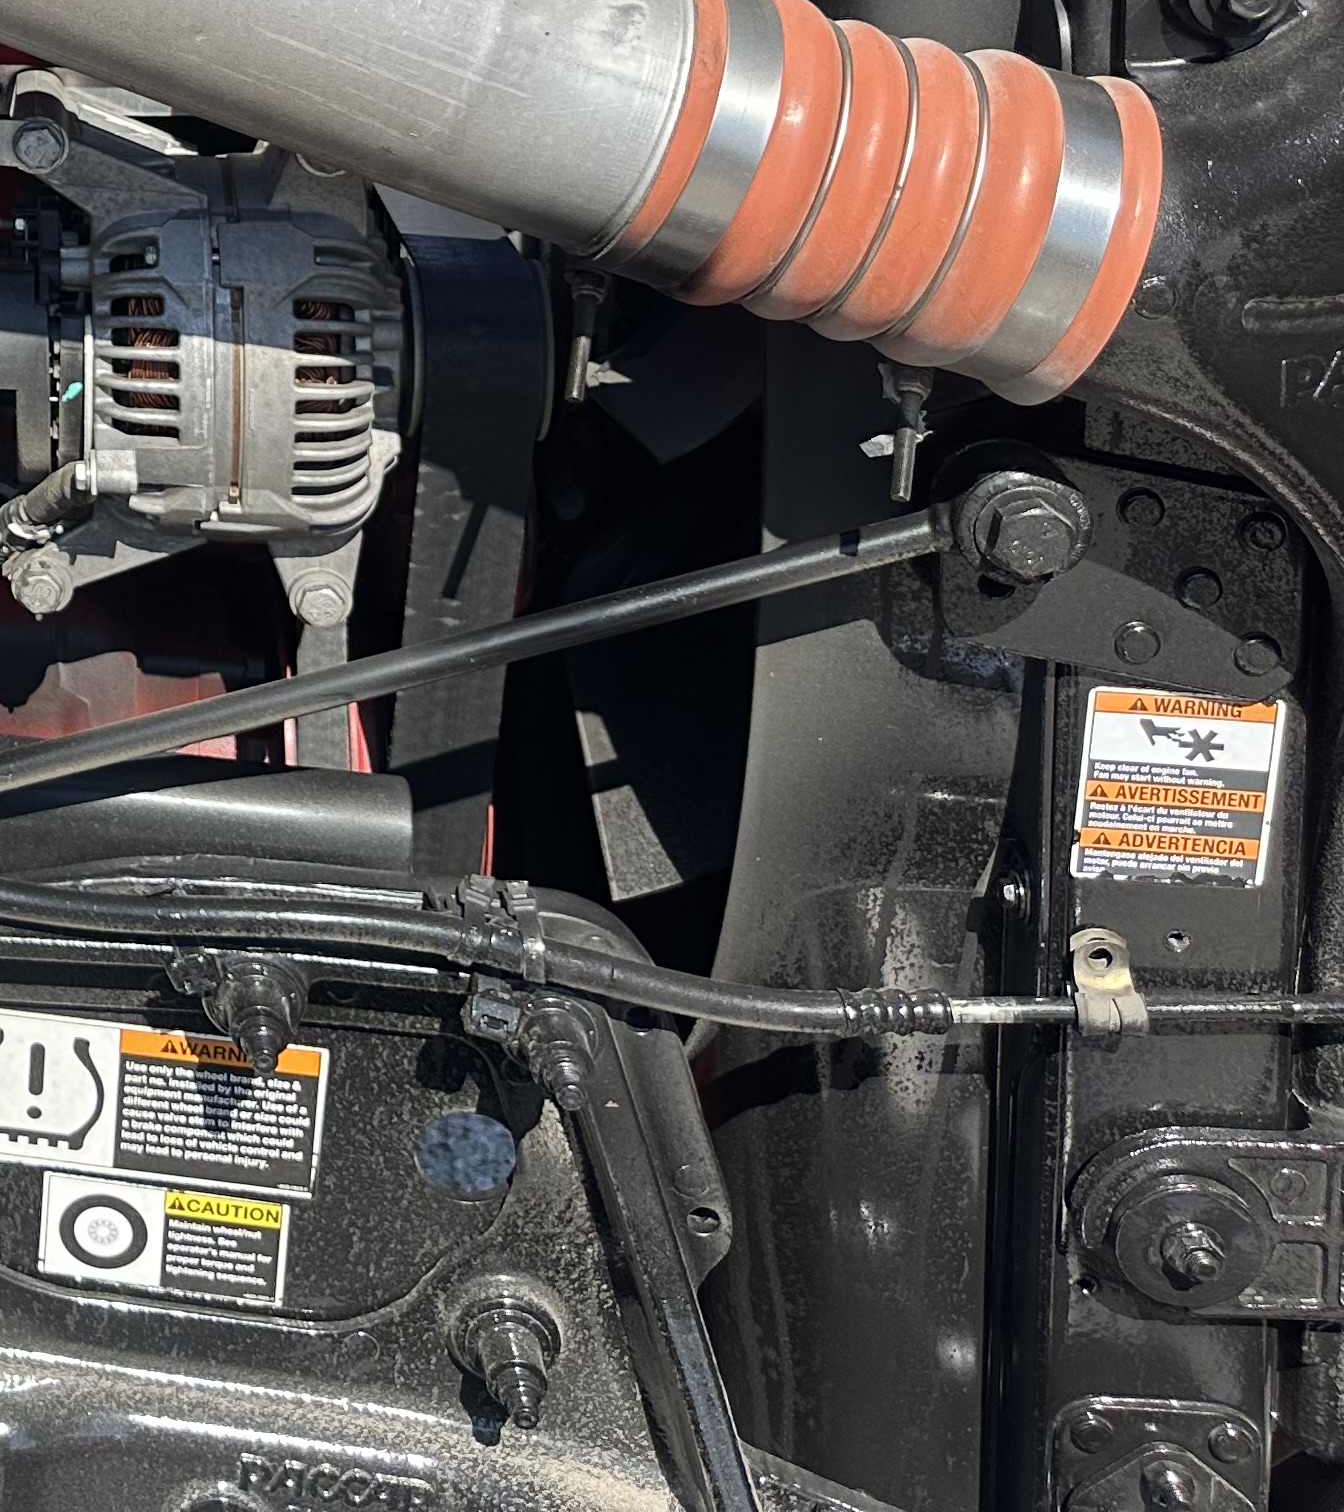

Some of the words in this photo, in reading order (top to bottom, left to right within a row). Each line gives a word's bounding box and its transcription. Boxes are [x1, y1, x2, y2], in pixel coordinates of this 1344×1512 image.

[1154, 697, 1242, 717] WARNING
[1093, 770, 1109, 779] Fan
[1111, 773, 1129, 782] may
[1130, 773, 1152, 782] start
[1153, 774, 1185, 785] without
[1187, 778, 1225, 788] warning.
[1094, 762, 1115, 772] Keep
[1118, 763, 1138, 773] clear
[1140, 765, 1150, 773] of
[1151, 766, 1180, 777] engine
[1182, 767, 1198, 777] fan.
[1114, 784, 1262, 809] AVERTISSEMENT
[1090, 801, 1118, 811] Restez
[1156, 807, 1168, 815] du
[1169, 808, 1216, 818] ventilateur
[1217, 811, 1228, 819] du
[1122, 813, 1154, 823] Celui-ci
[1157, 816, 1189, 827] pourrait
[1204, 818, 1233, 828] mettre
[1087, 819, 1147, 830] soudainement
[1118, 833, 1246, 855] ADVERTENCIA
[1085, 848, 1136, 859] Mantengase
[1138, 851, 1168, 862] alejado
[1170, 853, 1184, 863] del
[1186, 855, 1228, 867] ventilador
[1230, 858, 1243, 867] del
[1111, 859, 1138, 869] puede
[1139, 861, 1176, 871] arrancar
[1177, 863, 1191, 872] sin
[1192, 865, 1219, 874] previo
[181, 1041, 249, 1063] WARNI
[124, 1073, 147, 1086] part
[148, 1077, 166, 1087] no.
[169, 1077, 215, 1093] installed
[217, 1083, 231, 1096] by
[233, 1084, 252, 1096] the
[253, 1089, 297, 1102] original
[125, 1061, 147, 1073] Use
[149, 1063, 173, 1079] only
[175, 1065, 195, 1079] the
[196, 1070, 227, 1081] wheel
[267, 1078, 290, 1090] size
[292, 1081, 302, 1092] &
[124, 1085, 182, 1100] equipment
[183, 1092, 260, 1109] manufacturer.
[261, 1102, 285, 1114] Use
[286, 1103, 298, 1115] of
[122, 1107, 156, 1120] cause
[157, 1112, 187, 1124] valve
[188, 1114, 215, 1127] stem
[218, 1118, 230, 1128] to
[231, 1119, 278, 1134] interfere
[279, 1125, 304, 1138] with
[123, 1096, 169, 1110] different
[171, 1101, 204, 1115] wheel
[206, 1106, 237, 1119] brand
[239, 1111, 253, 1120] or
[254, 1111, 277, 1124] size
[278, 1114, 311, 1128] could
[122, 1120, 130, 1129] a
[131, 1119, 161, 1132] brake
[163, 1124, 226, 1140] component
[226, 1131, 260, 1144] which
[262, 1134, 294, 1148] could
[120, 1129, 145, 1142] lead
[146, 1132, 159, 1143] to
[160, 1134, 184, 1146] loss
[185, 1135, 198, 1147] of
[199, 1137, 239, 1152] vehicle
[240, 1142, 279, 1156] control
[280, 1146, 303, 1161] and
[120, 1141, 144, 1154] may
[146, 1142, 169, 1155] lead
[170, 1146, 183, 1157] to
[184, 1148, 232, 1164] personal
[234, 1152, 270, 1169] injury.
[187, 1199, 279, 1223] CAUTION
[169, 1219, 211, 1232] Maintain
[168, 1230, 216, 1245] tightness.
[217, 1237, 237, 1248] See
[166, 1254, 199, 1265] proper
[201, 1258, 234, 1270] torque
[235, 1263, 255, 1273] and
[167, 1242, 218, 1257] operator's
[218, 1249, 256, 1262] manual
[257, 1253, 272, 1264] for
[166, 1264, 215, 1280] tightening
[216, 1272, 267, 1286] sequence.
